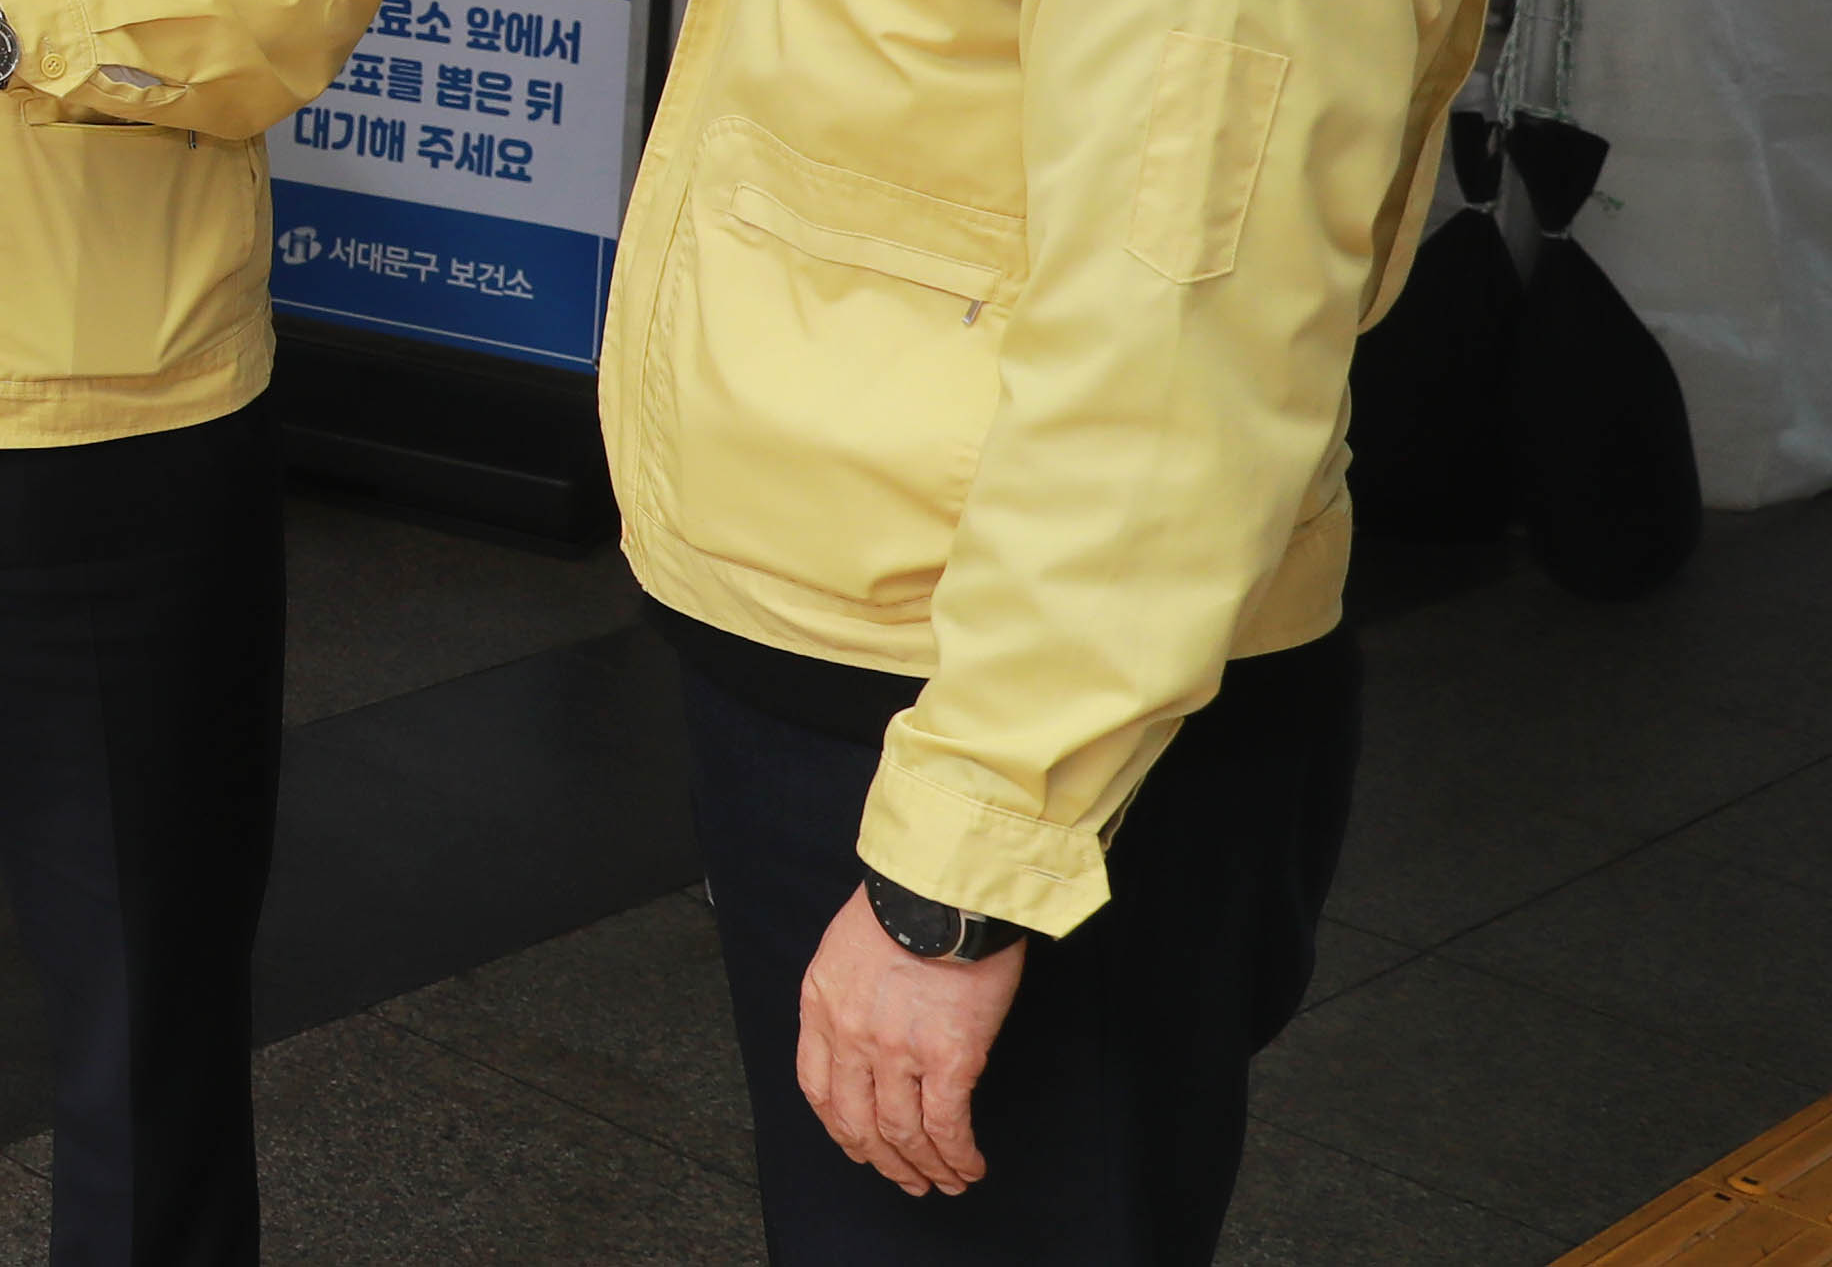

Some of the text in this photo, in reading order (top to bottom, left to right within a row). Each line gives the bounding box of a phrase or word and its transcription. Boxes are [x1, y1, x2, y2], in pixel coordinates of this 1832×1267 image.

[466, 6, 582, 65] 앞에서
[329, 52, 564, 125] 표를 뽑은 뒤
[294, 106, 534, 183] 대기해 주세요
[328, 237, 535, 300] 서대문구 보건소
